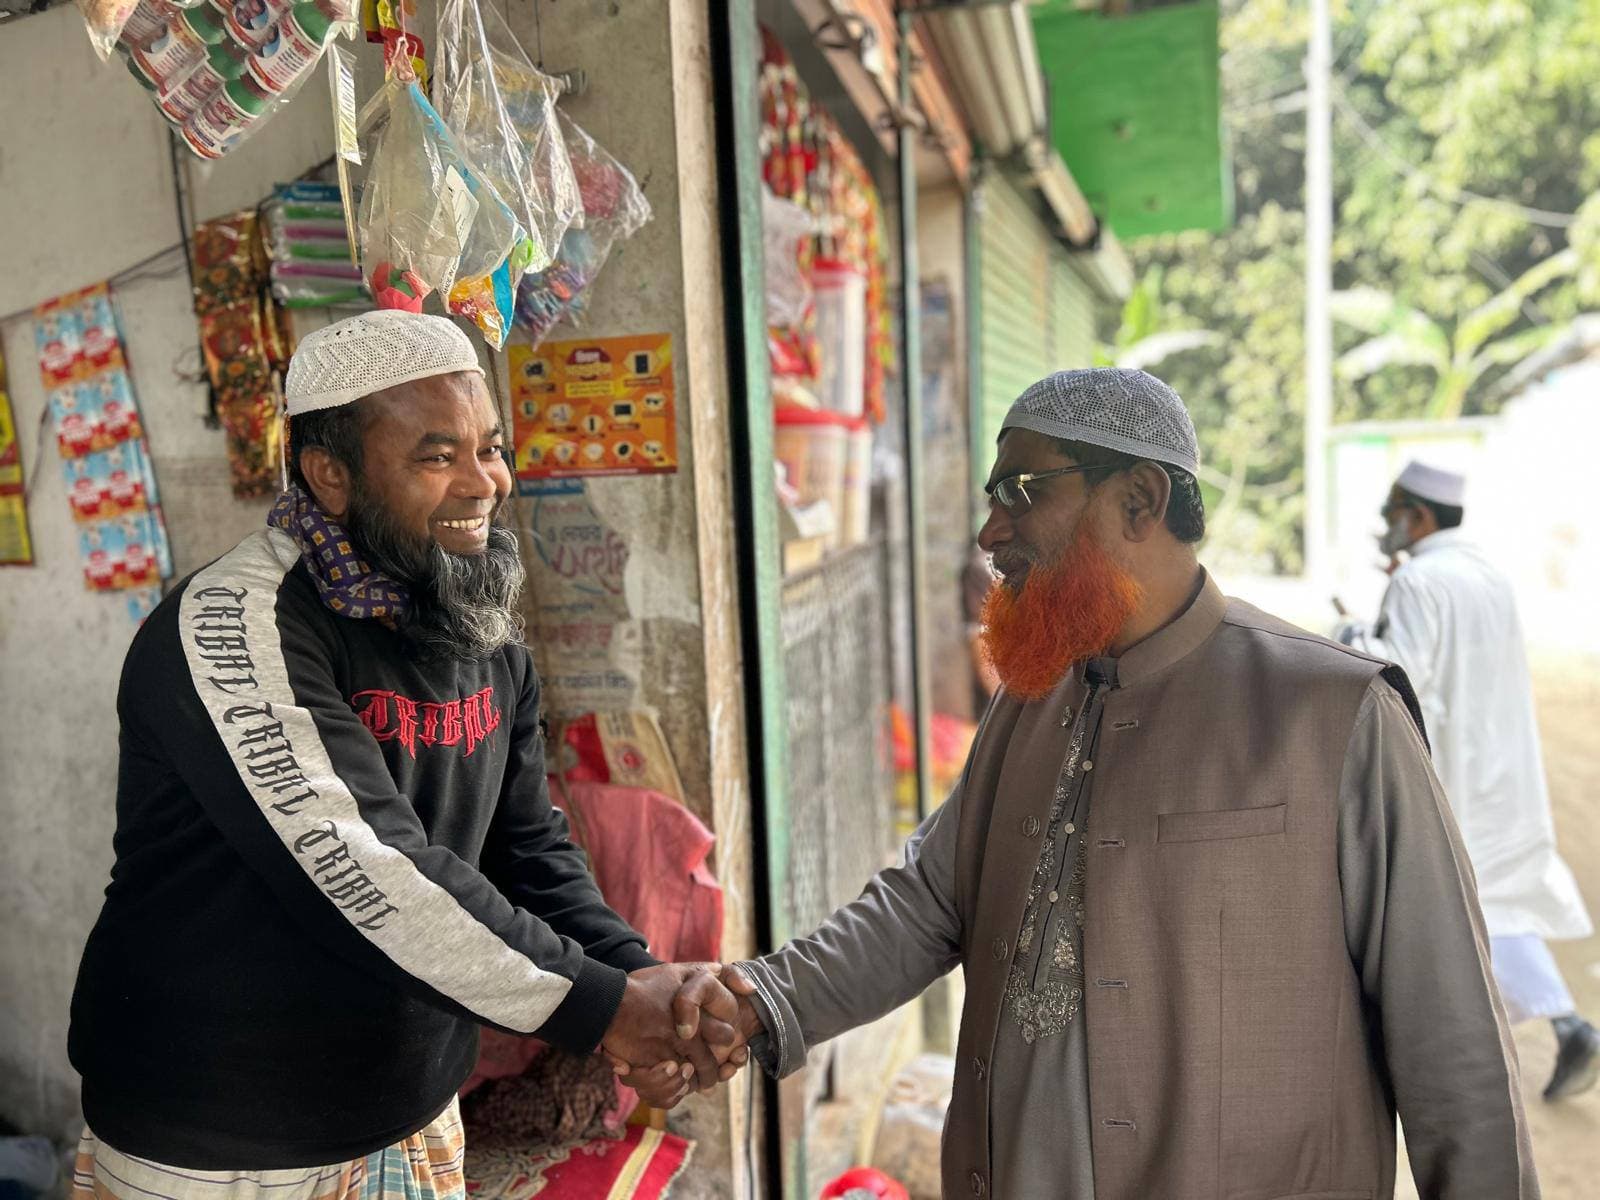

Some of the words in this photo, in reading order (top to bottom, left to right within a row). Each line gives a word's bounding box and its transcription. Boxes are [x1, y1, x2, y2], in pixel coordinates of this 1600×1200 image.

[192, 586, 258, 694] TRIBAL
[223, 702, 319, 816] TRIBAL
[352, 686, 502, 760] TRIBAL
[294, 820, 399, 931] TRIBAL
